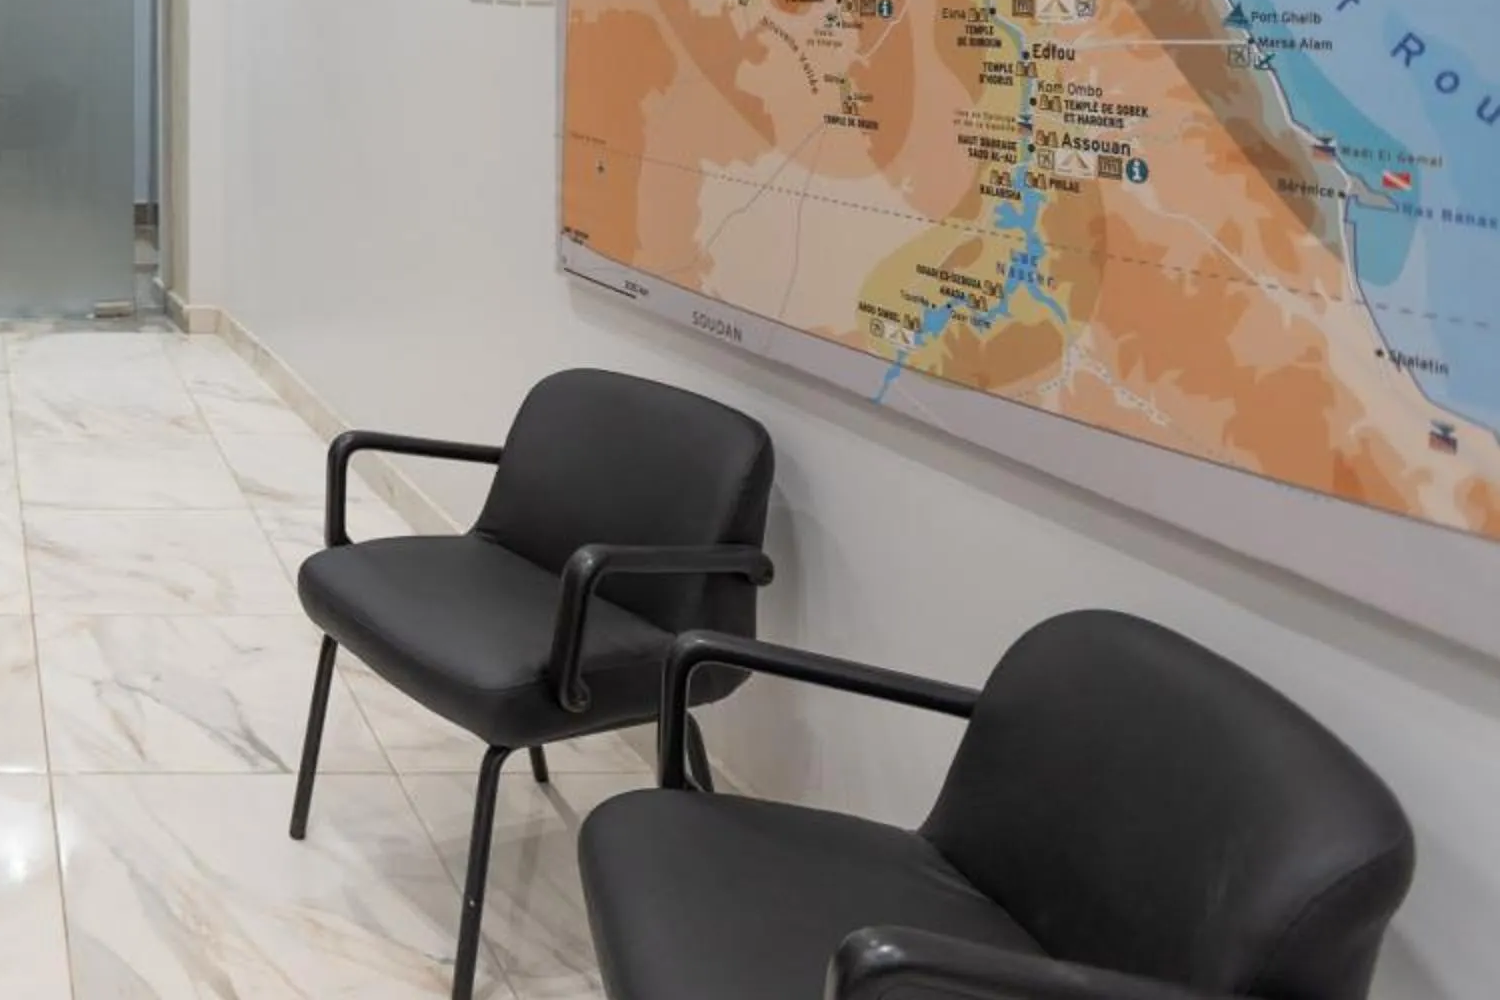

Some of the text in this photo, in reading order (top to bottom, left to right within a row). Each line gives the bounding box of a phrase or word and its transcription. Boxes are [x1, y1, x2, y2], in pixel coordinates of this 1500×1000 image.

[1251, 10, 1278, 24] Port
[1032, 43, 1076, 62] Edfou
[1299, 37, 1333, 50] Alam
[1037, 80, 1103, 98] Kom Ombo
[1061, 132, 1132, 156] Assouan
[691, 310, 743, 343] SOUDAN
